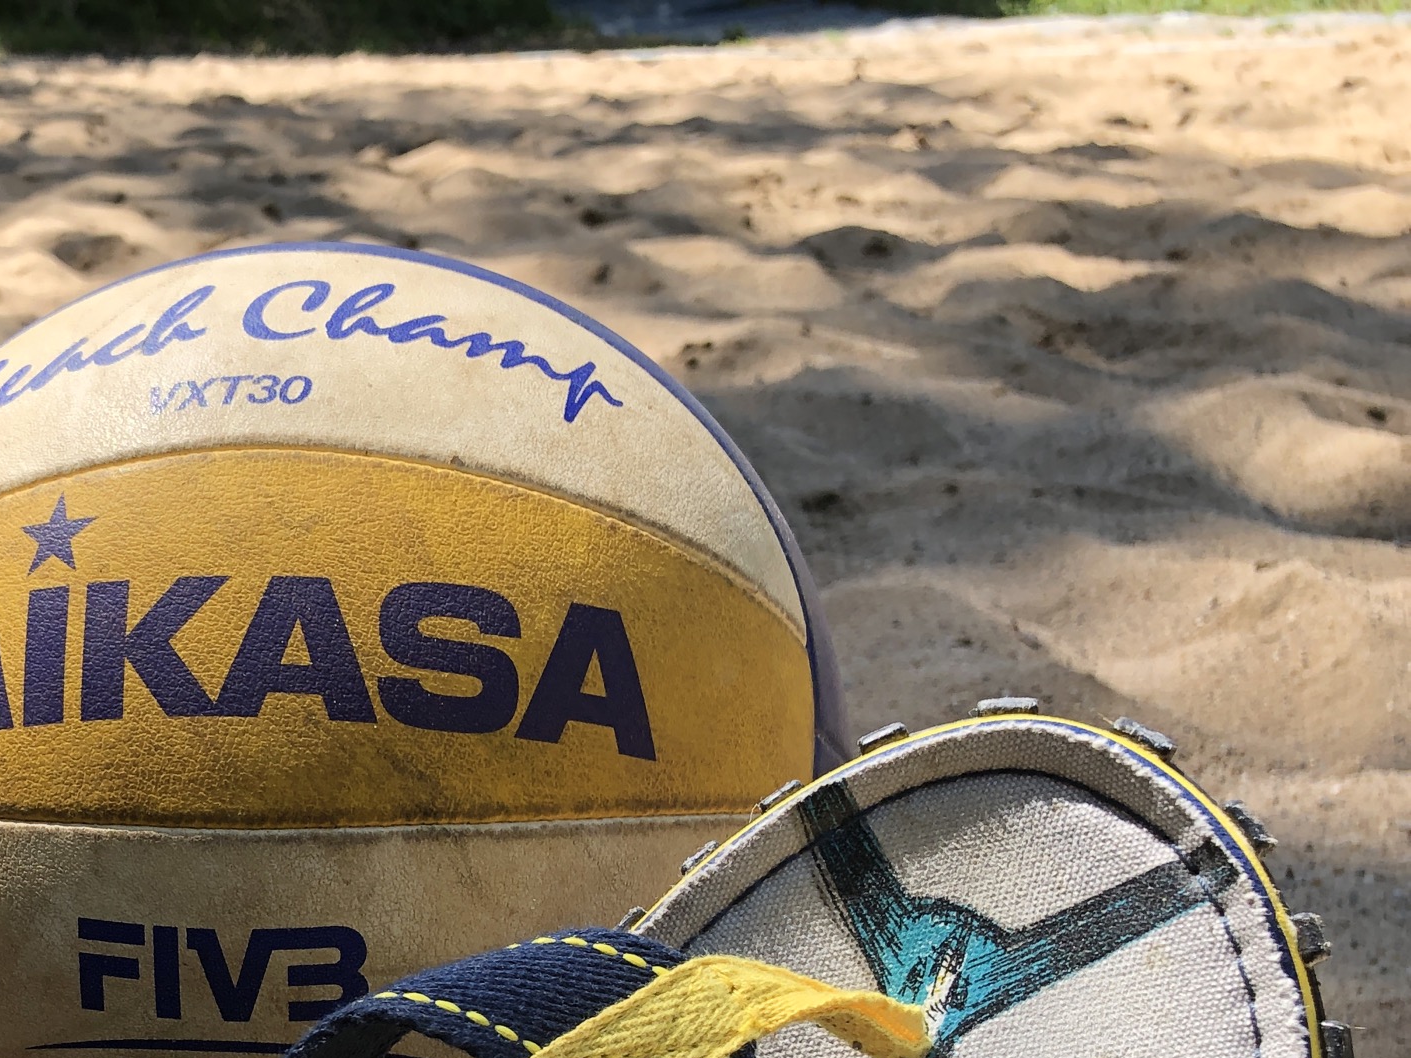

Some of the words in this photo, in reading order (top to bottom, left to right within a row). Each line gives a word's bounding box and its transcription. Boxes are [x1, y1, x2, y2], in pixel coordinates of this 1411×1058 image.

[149, 374, 313, 416] VXT30
[242, 280, 625, 422] Champ
[77, 916, 370, 1023] FIVB
